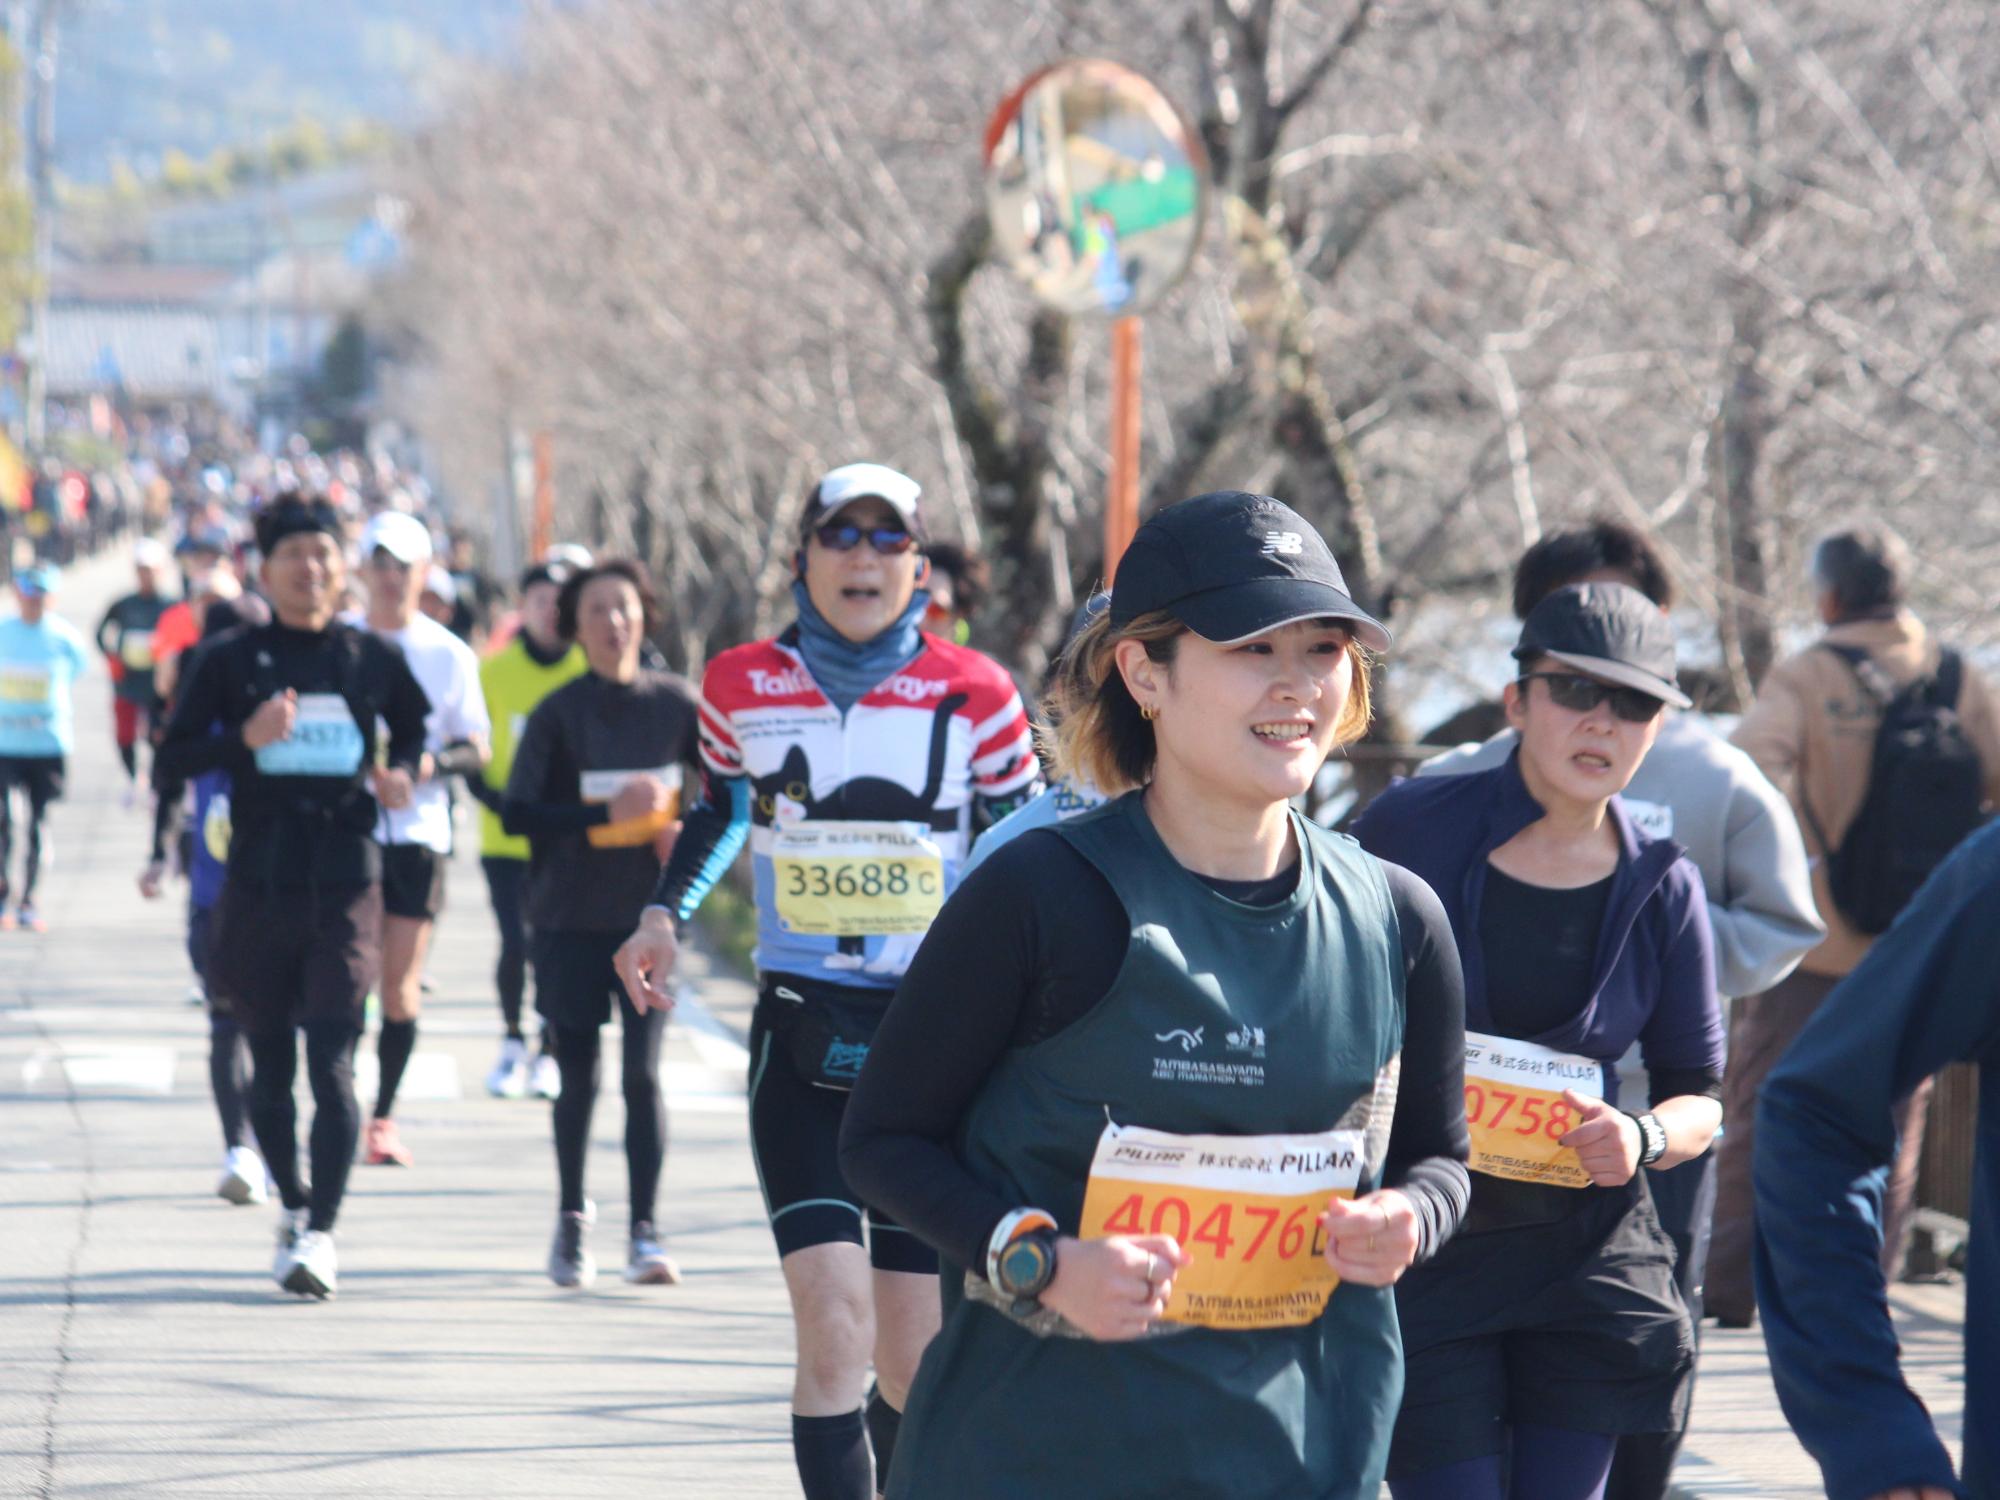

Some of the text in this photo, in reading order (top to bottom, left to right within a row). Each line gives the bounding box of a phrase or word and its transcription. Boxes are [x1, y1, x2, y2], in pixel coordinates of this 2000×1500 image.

[876, 832, 919, 847] PILLA
[787, 862, 936, 897] 33688 C
[1152, 1057, 1265, 1078] TAMBASASAYAMA
[1177, 1071, 1236, 1085] MARATHON
[1546, 1060, 1597, 1081] PILLAR
[1464, 1084, 1572, 1141] 0758
[1279, 1150, 1356, 1175] PILLAR
[1102, 1193, 1309, 1263] 40476
